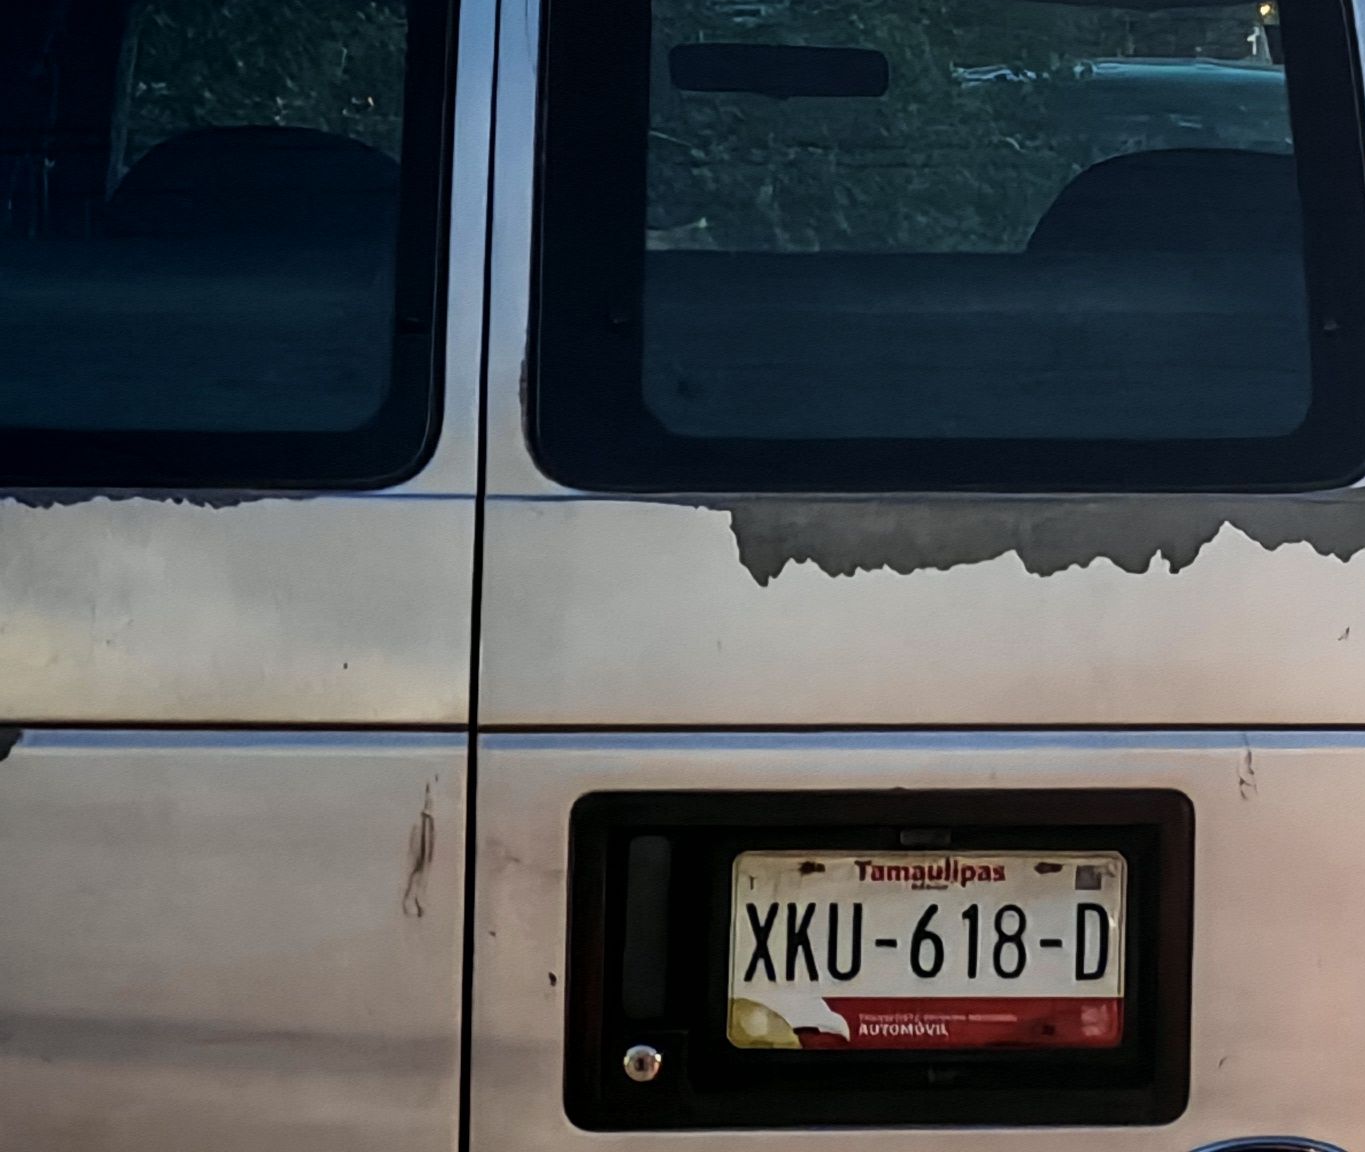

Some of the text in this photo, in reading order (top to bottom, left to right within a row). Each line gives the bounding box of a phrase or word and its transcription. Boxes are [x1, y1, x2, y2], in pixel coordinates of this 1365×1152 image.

[854, 858, 1006, 888] Tamaulipas
[743, 902, 1110, 982] XKU-618-D
[858, 1021, 949, 1037] AUTOMÓVIL
